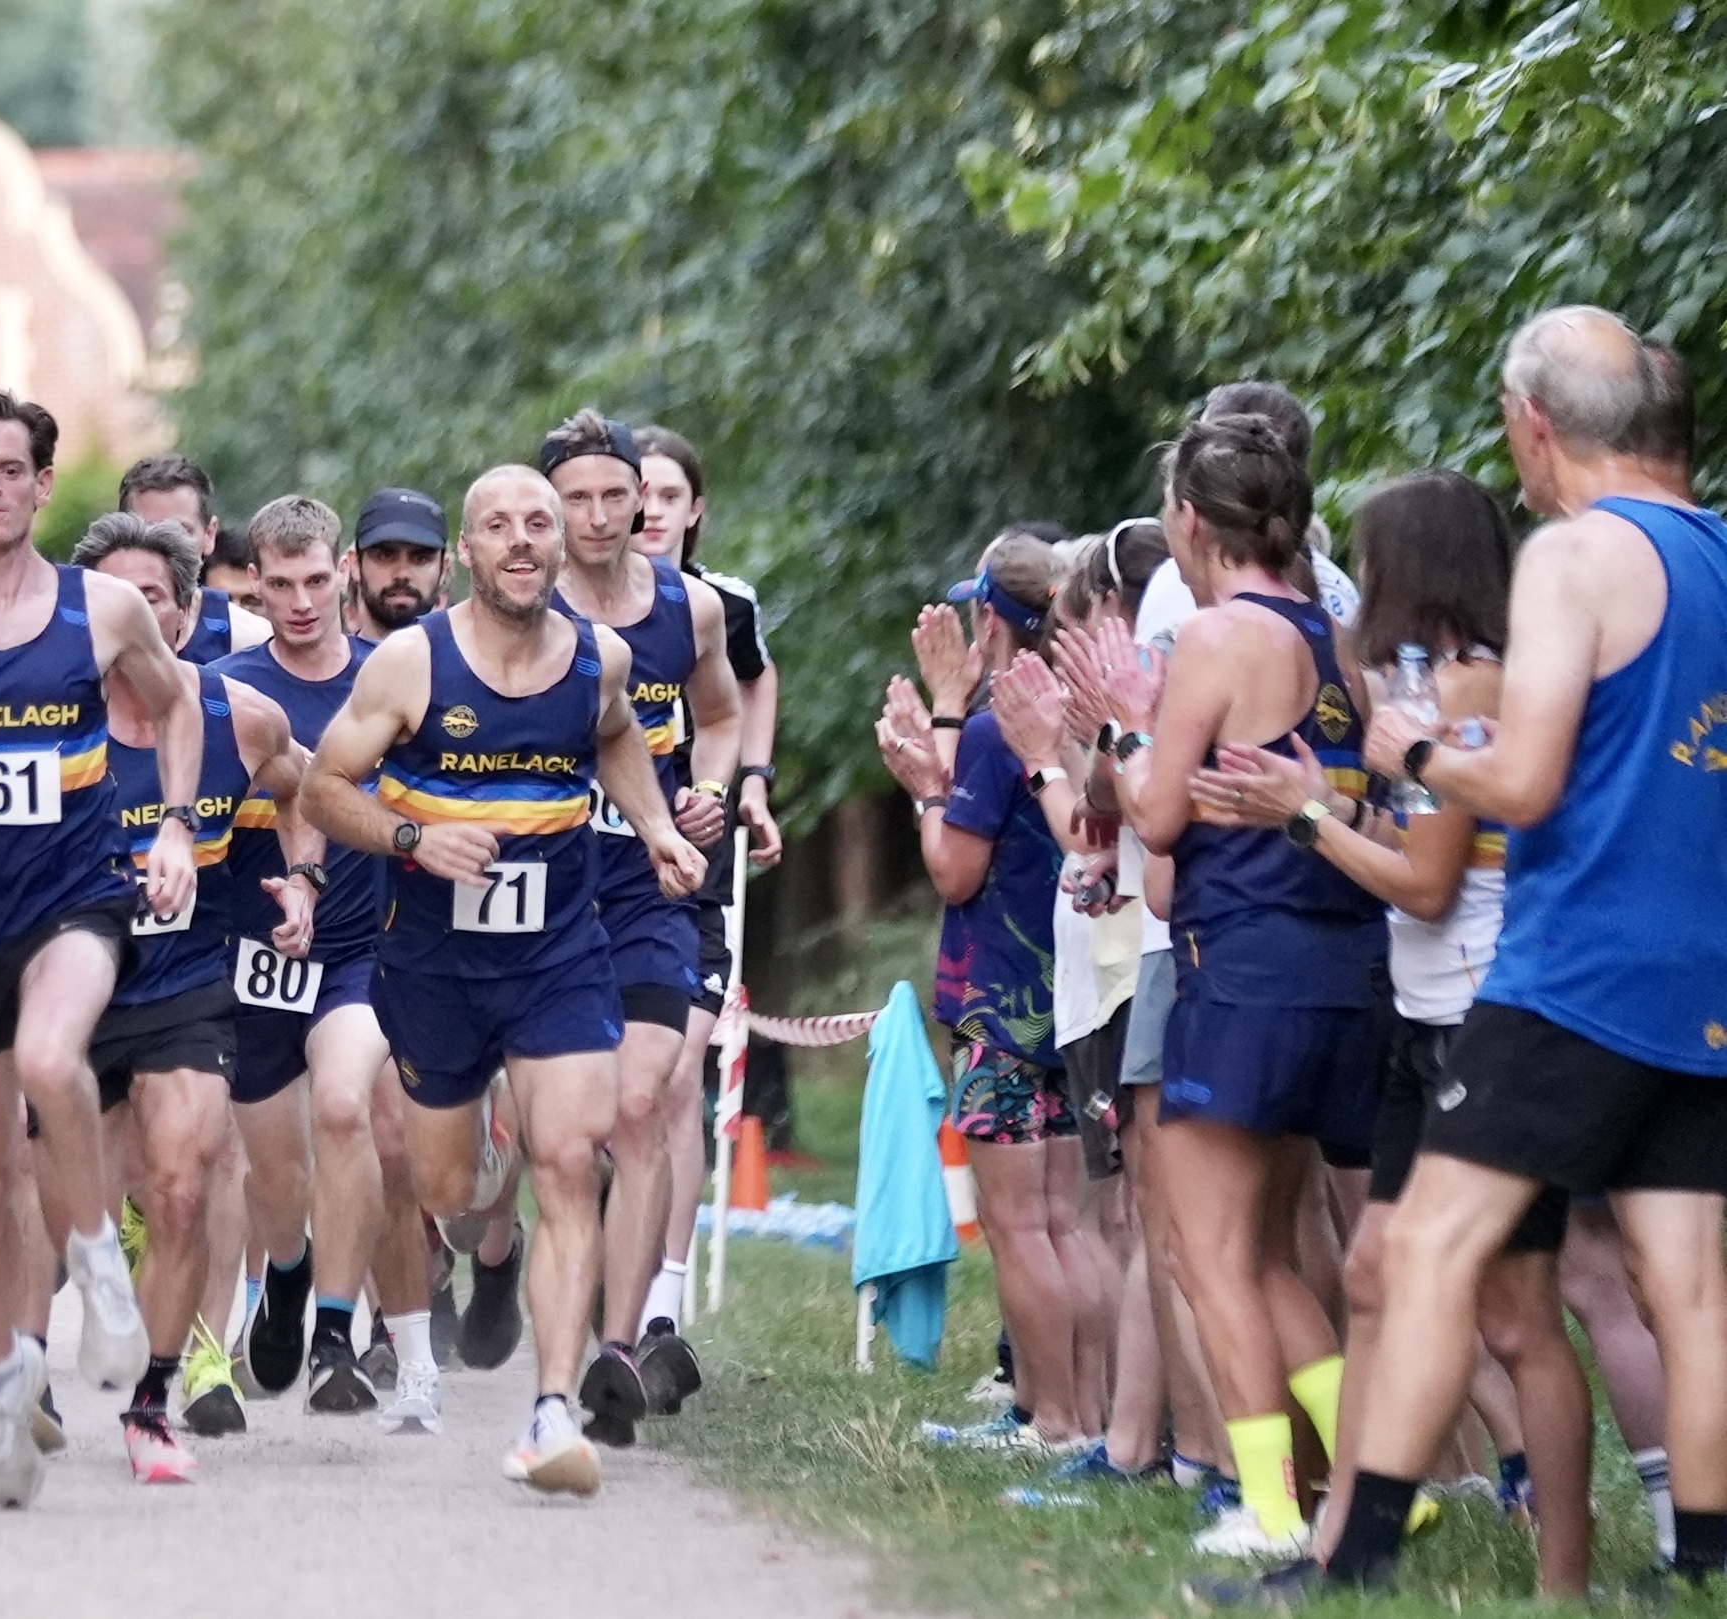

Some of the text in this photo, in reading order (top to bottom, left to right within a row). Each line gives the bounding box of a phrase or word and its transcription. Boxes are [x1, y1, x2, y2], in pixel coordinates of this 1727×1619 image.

[121, 796, 233, 829] NEGH
[478, 871, 527, 925] 71
[247, 949, 309, 1005] 80
